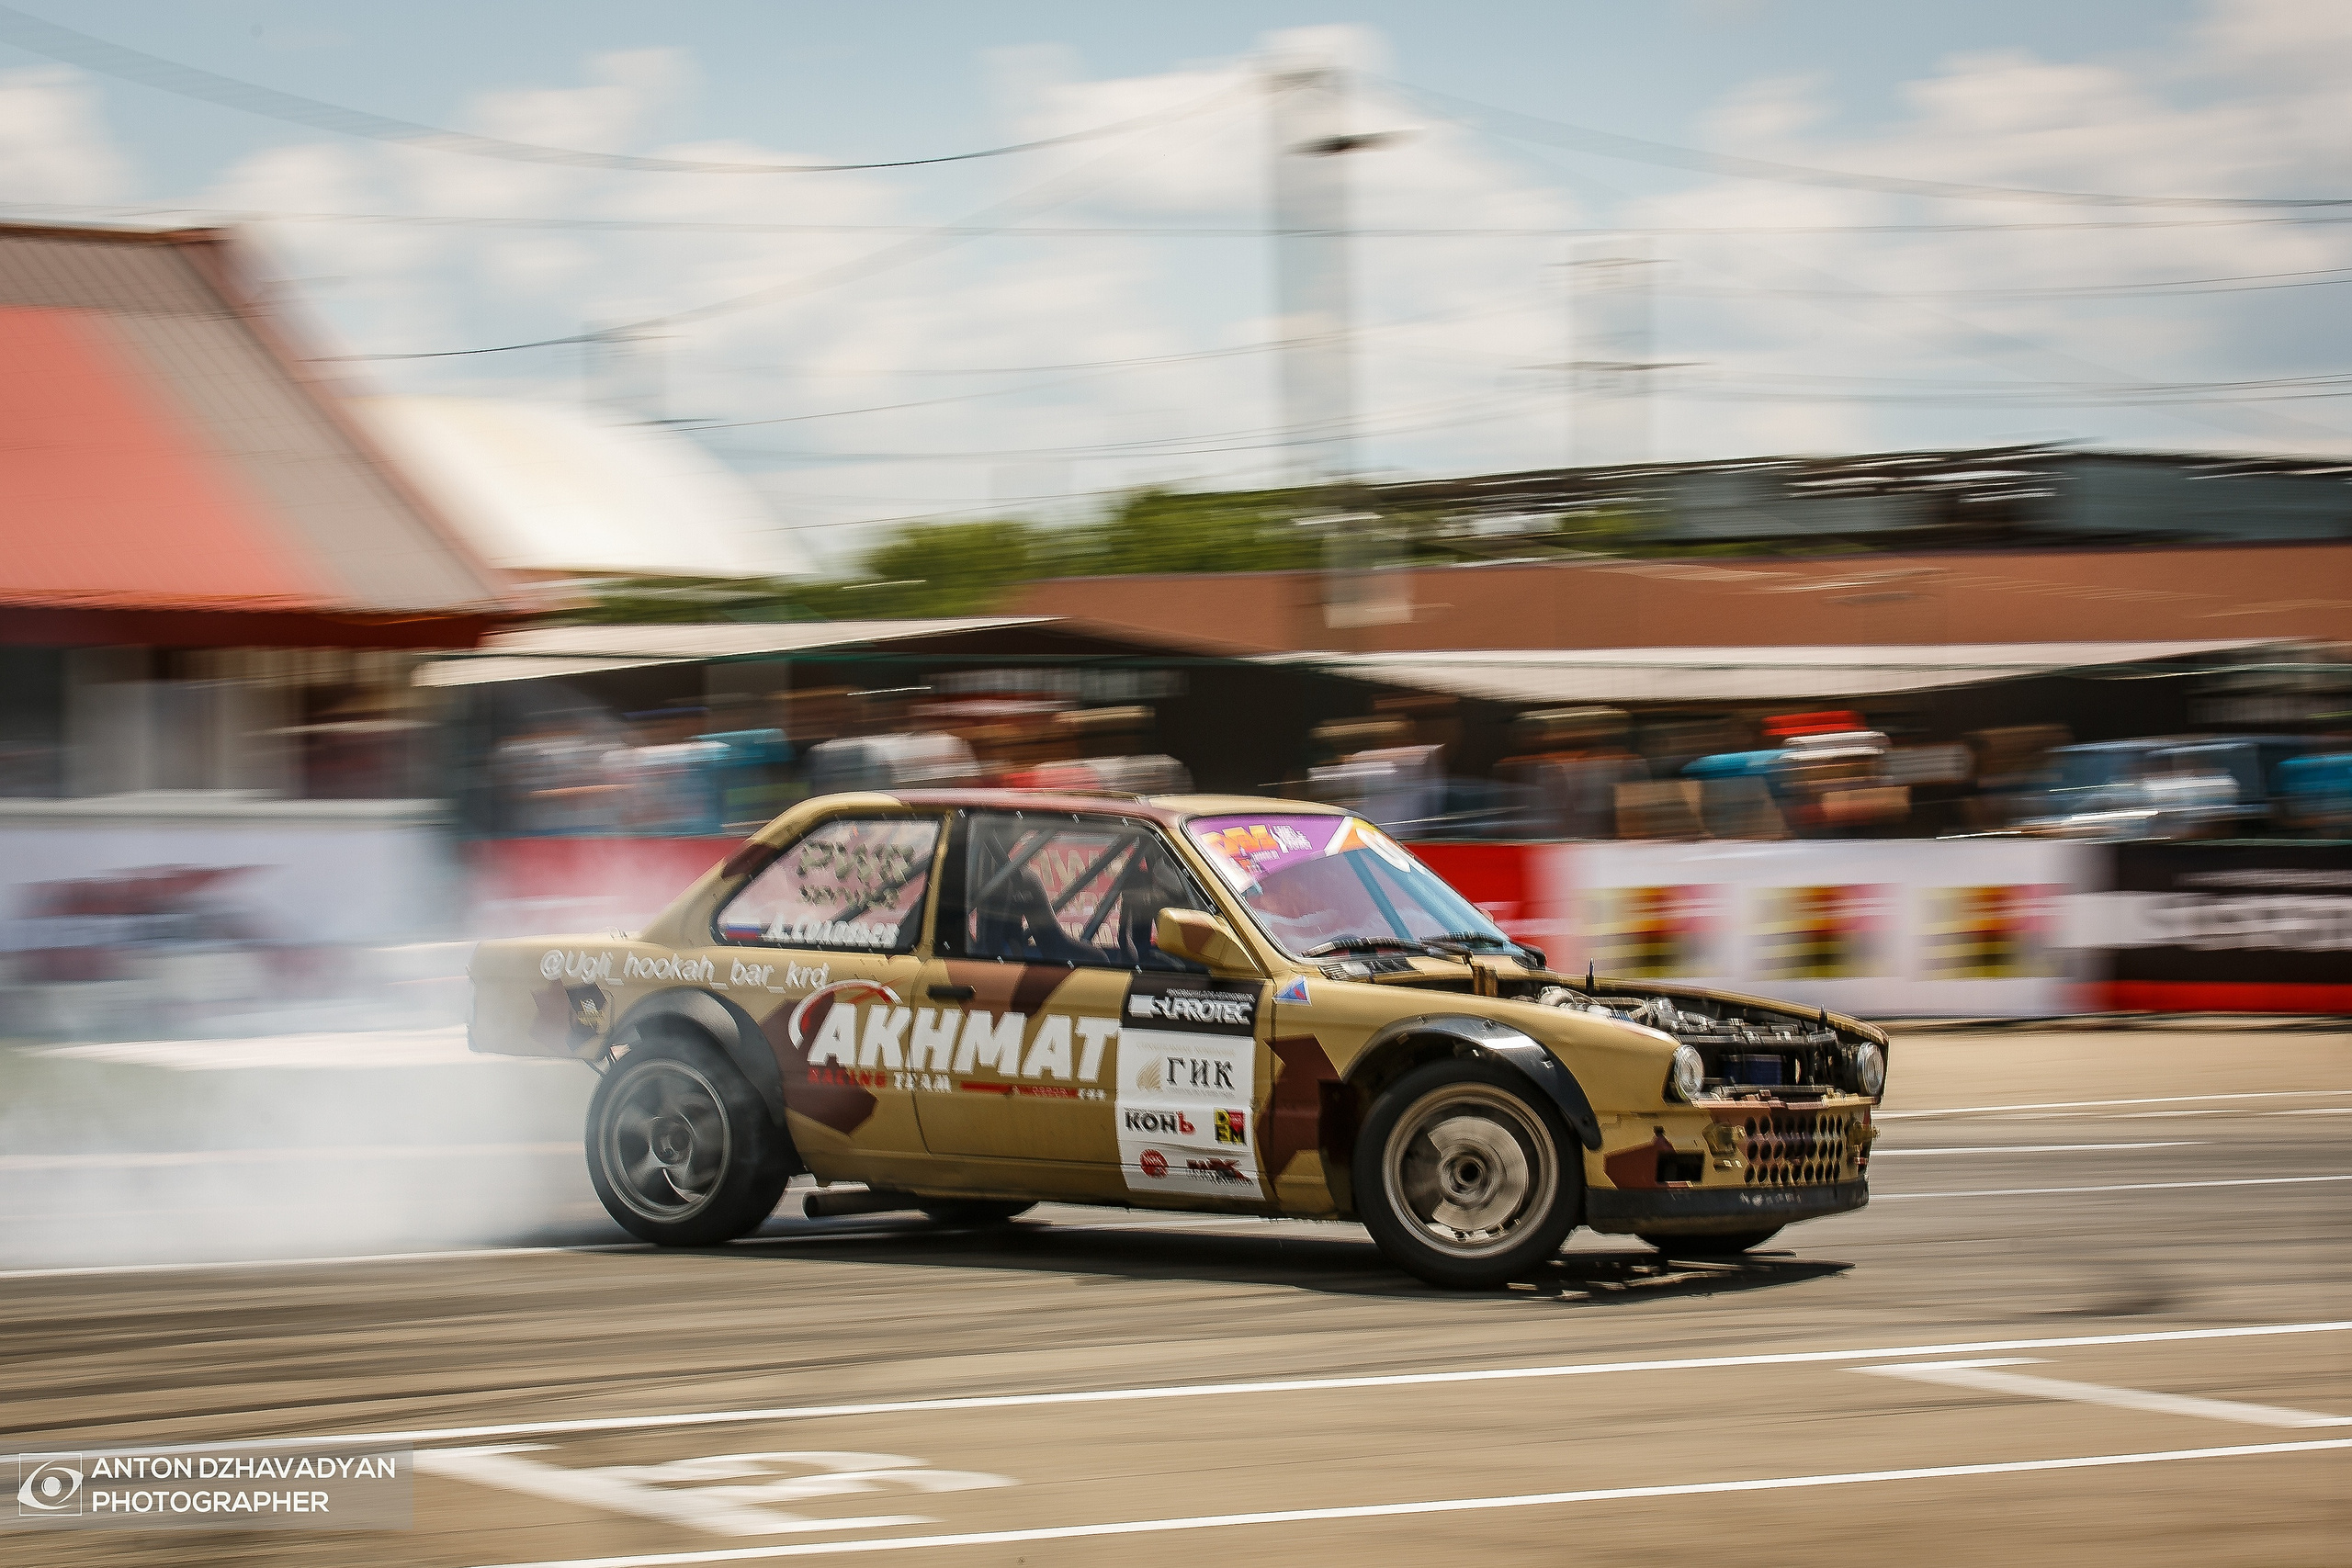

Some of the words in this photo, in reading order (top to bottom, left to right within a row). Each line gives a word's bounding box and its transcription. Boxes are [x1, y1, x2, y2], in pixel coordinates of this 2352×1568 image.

[807, 1001, 1121, 1083] AKHMAT
[808, 1066, 888, 1089] RACING
[893, 1070, 953, 1094] TEAM
[1166, 1056, 1236, 1091] ГИК
